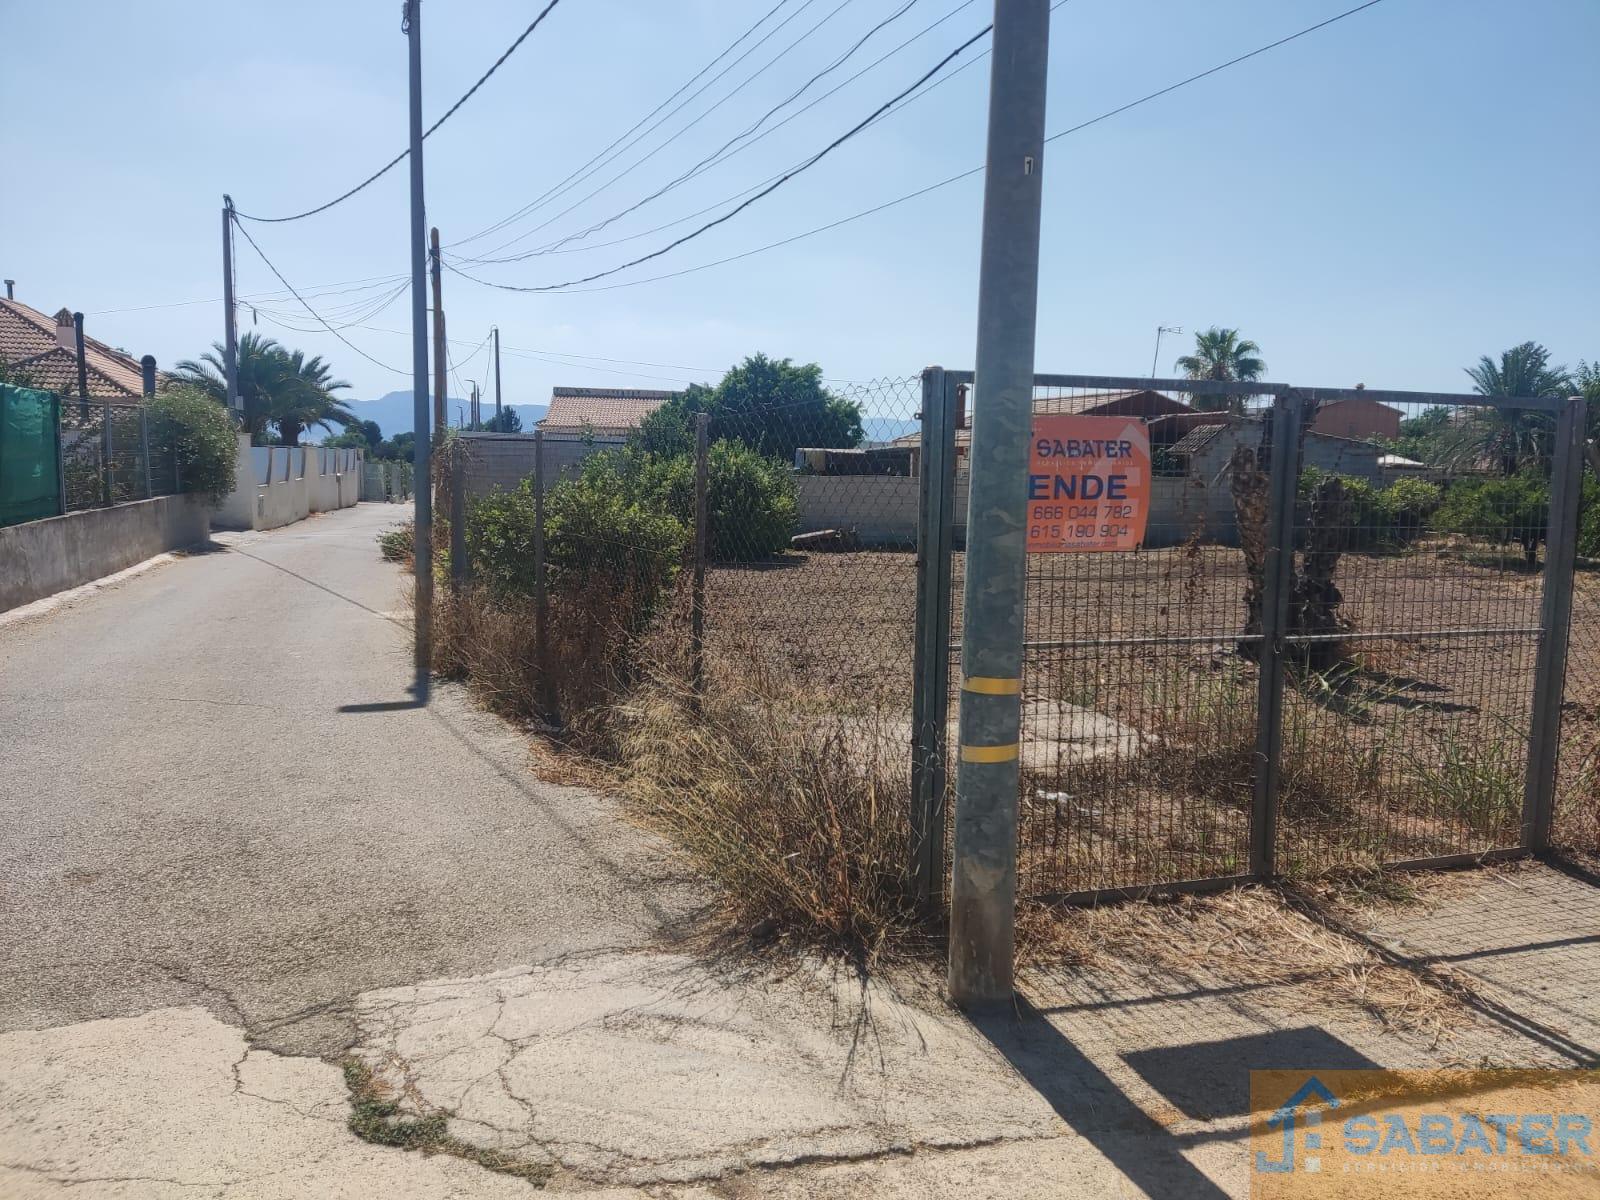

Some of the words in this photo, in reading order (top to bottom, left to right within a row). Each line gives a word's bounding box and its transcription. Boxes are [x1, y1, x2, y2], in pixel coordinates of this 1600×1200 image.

[1037, 438, 1133, 459] SABATER
[1029, 475, 1127, 499] ENDE
[1033, 506, 1063, 519] 666
[1068, 506, 1097, 519] 044
[1030, 525, 1060, 538] 615
[1068, 525, 1095, 537] 190
[1100, 524, 1128, 537] 904
